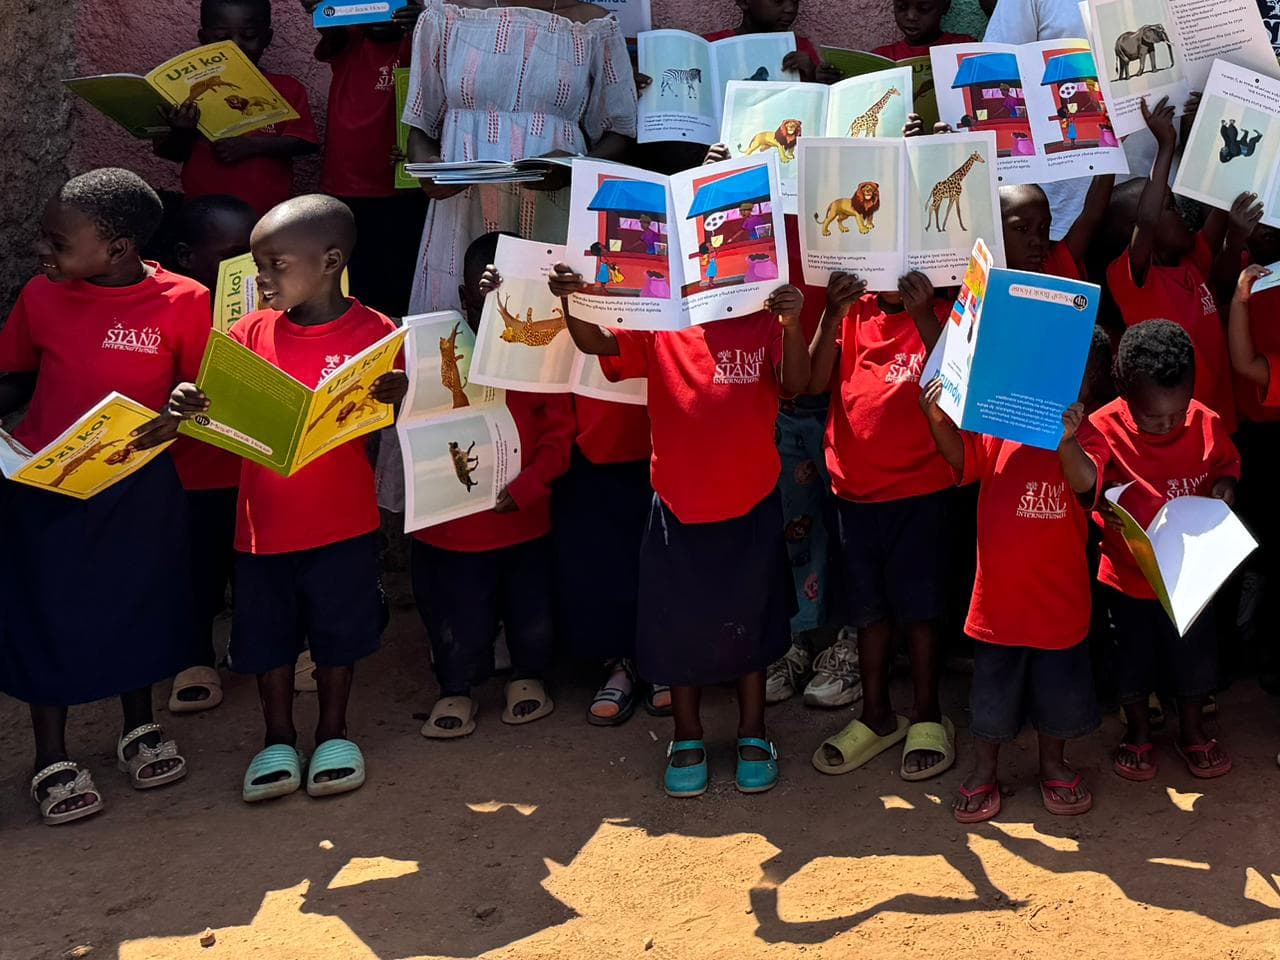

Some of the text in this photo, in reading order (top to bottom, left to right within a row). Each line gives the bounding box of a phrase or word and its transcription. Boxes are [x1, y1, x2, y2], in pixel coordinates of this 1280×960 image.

[166, 62, 197, 81] Uzi
[199, 51, 228, 67] ko!
[105, 329, 161, 348] STAND
[735, 349, 742, 364] I
[327, 344, 389, 394] Uzi ko!
[35, 445, 75, 470] Uzi
[78, 414, 111, 441] ko!
[1038, 482, 1047, 498] I
